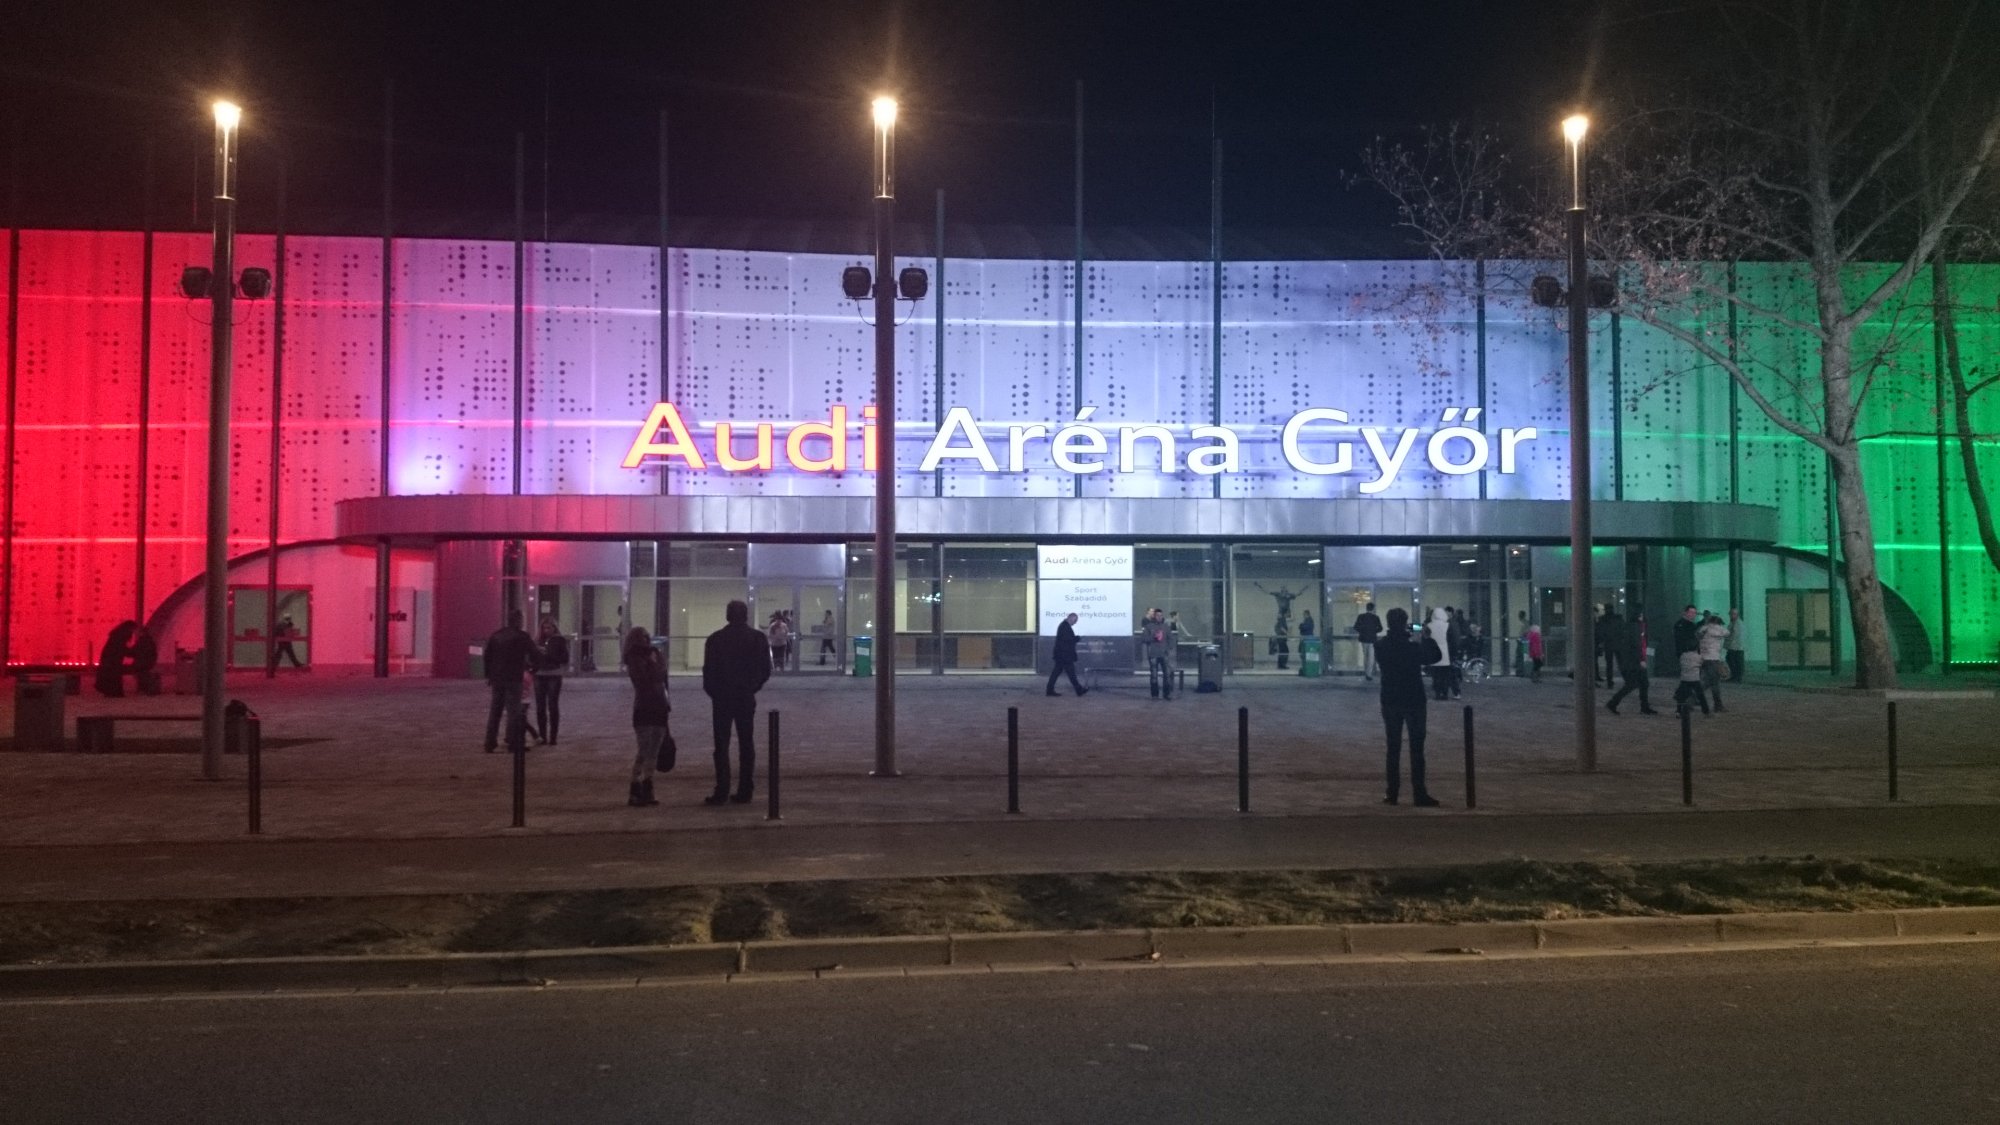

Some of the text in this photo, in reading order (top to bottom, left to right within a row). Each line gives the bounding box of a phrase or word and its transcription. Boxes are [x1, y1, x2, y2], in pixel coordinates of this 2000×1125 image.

[620, 401, 1538, 494] Audi Aréna Győr
[1045, 556, 1068, 564] Audi
[1074, 586, 1097, 594] Sport
